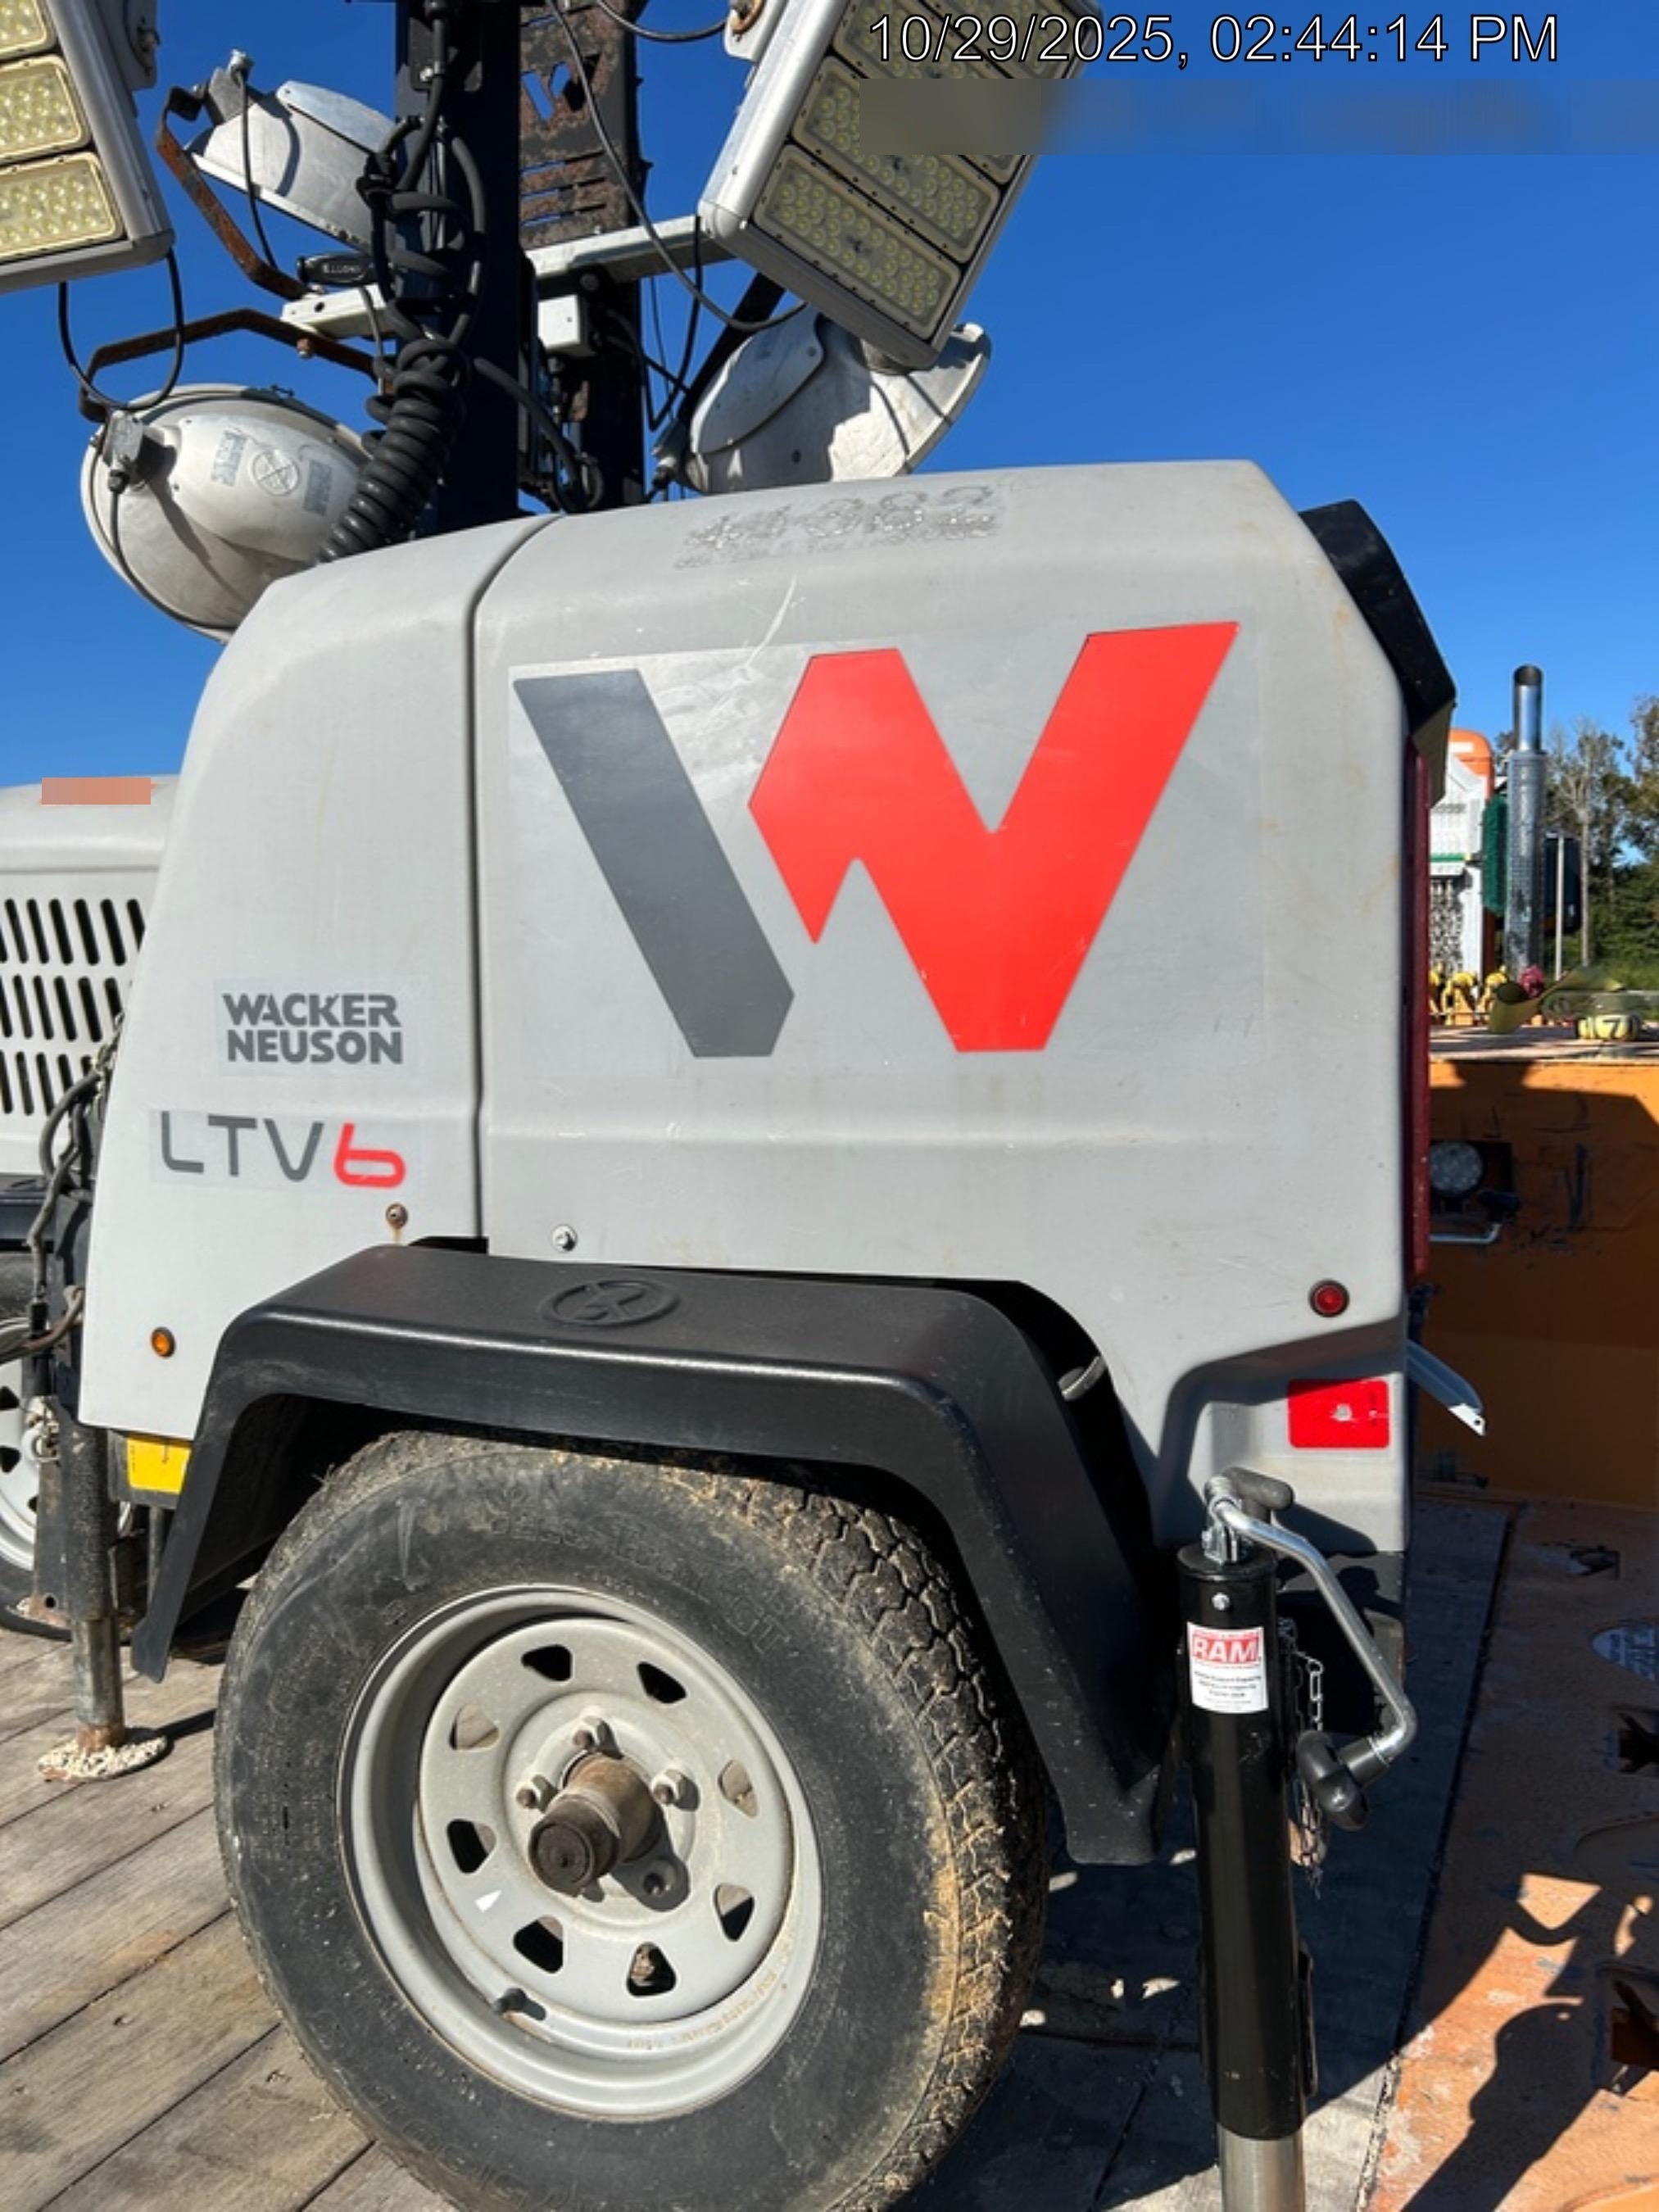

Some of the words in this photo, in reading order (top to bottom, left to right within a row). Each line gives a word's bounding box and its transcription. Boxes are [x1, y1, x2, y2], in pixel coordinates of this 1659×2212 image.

[222, 993, 402, 1028] WACKER
[227, 1029, 403, 1064] NEUSON
[161, 1110, 406, 1188] LTV6
[1193, 1638, 1258, 1664] RAM
